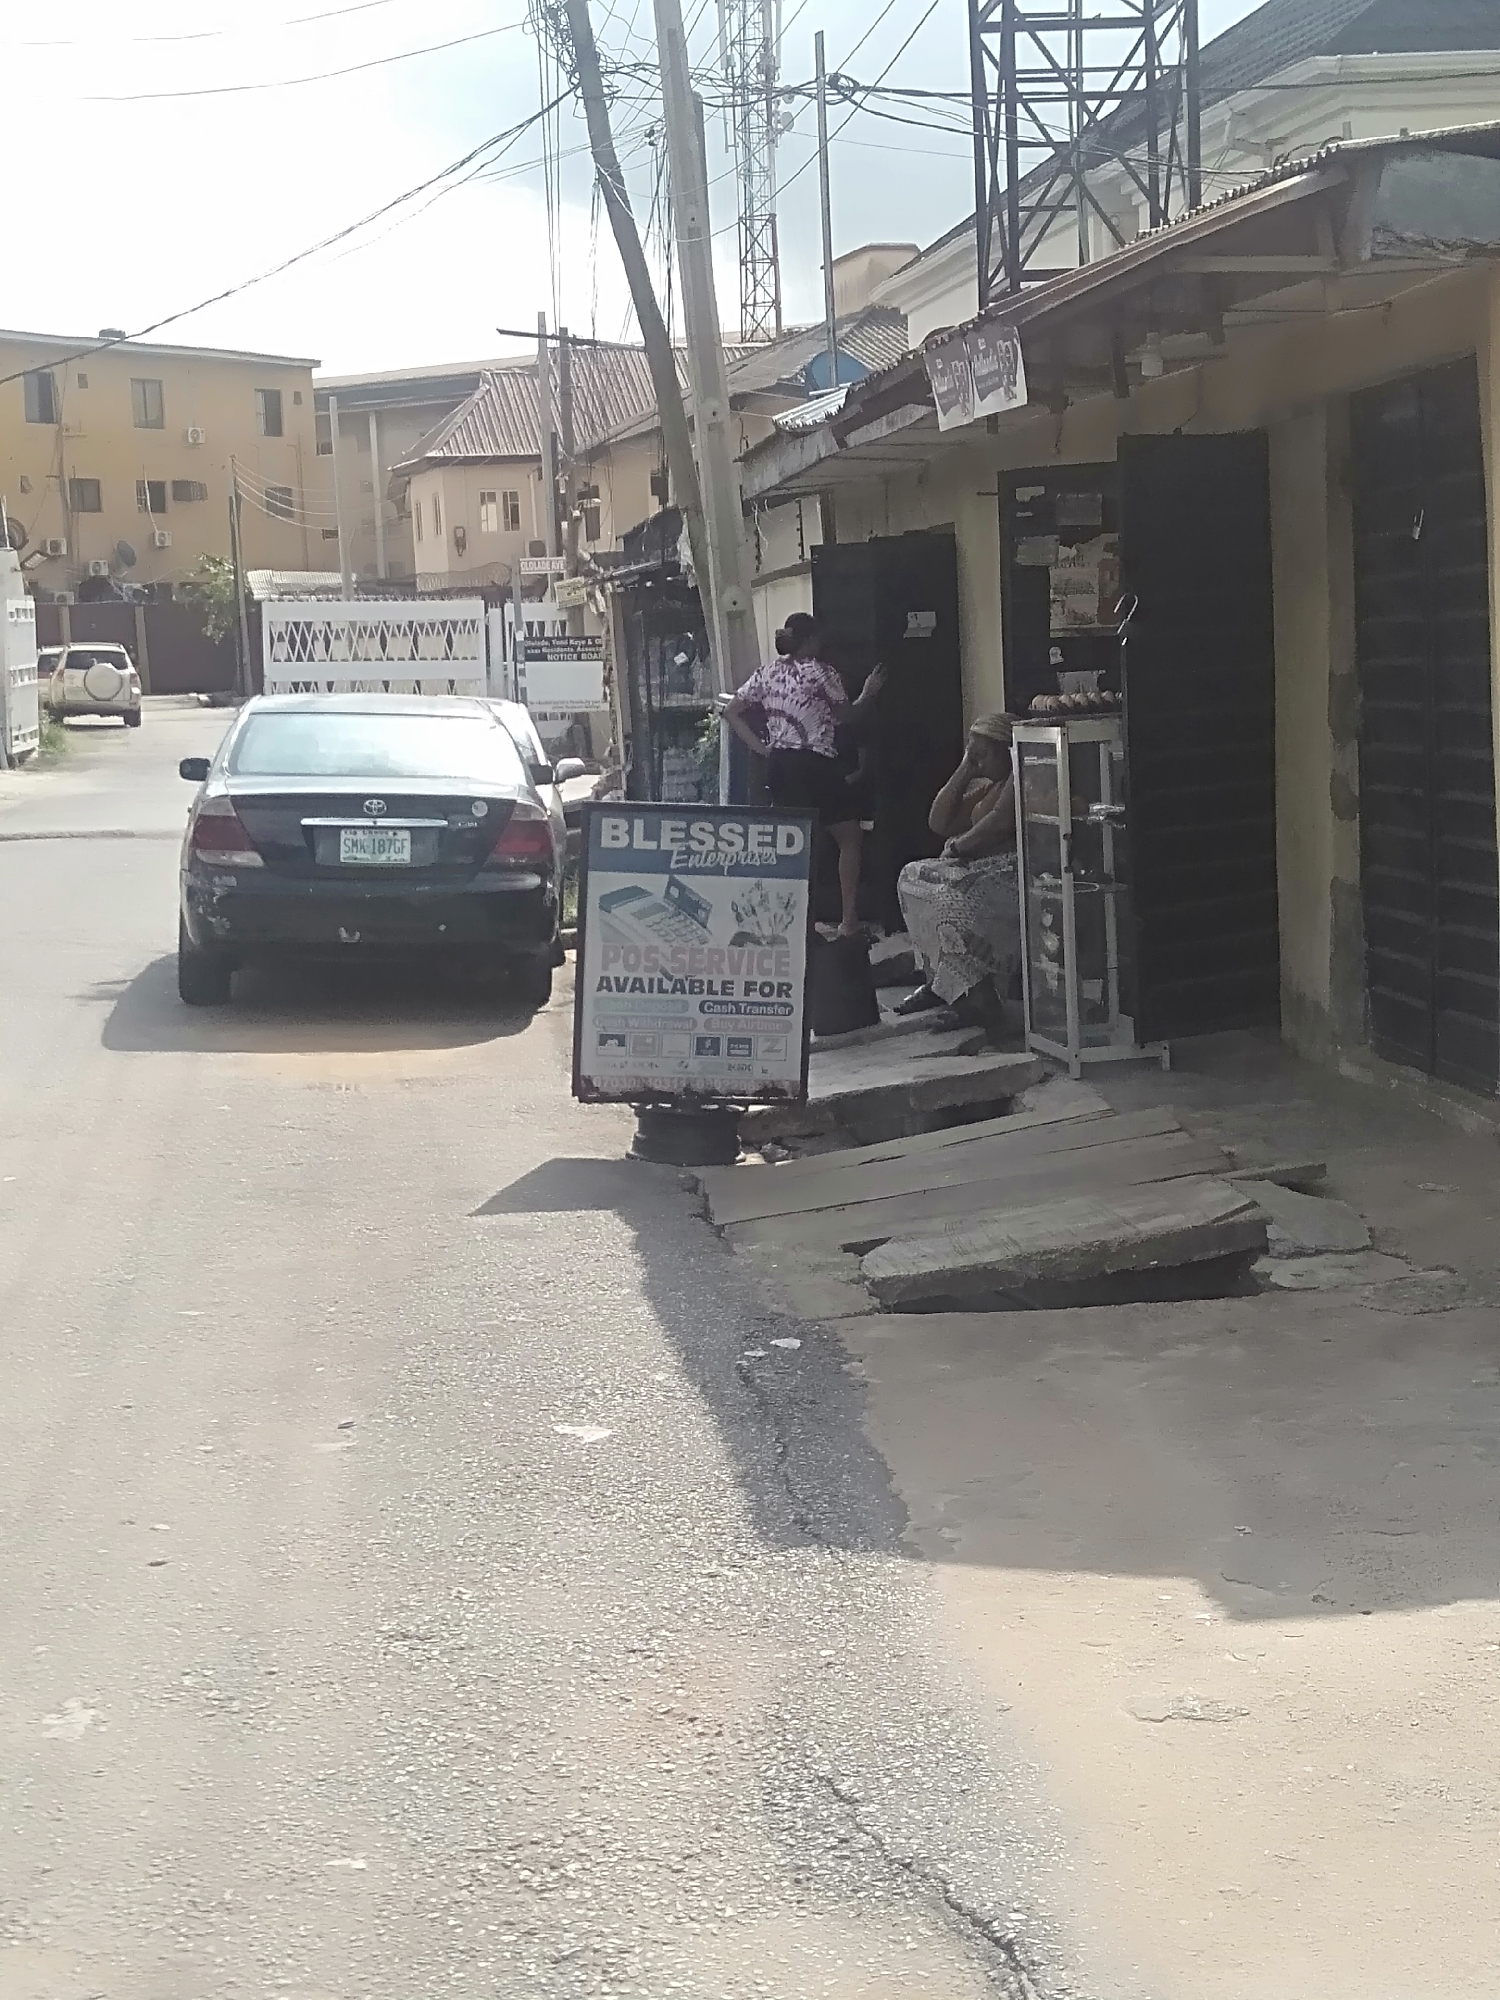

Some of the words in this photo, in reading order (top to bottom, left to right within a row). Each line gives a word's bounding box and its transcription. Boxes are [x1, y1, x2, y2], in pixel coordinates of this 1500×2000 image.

[600, 817, 805, 855] BLESSED
[670, 845, 778, 876] Enterprises
[601, 945, 661, 974] POS
[669, 947, 790, 977] SERVICE
[596, 975, 735, 997] AVAILABLE
[743, 980, 793, 998] FOR
[704, 1001, 736, 1014] Cash
[739, 1002, 792, 1016] Transfer
[628, 1017, 693, 1030] Withdrawal
[711, 1018, 735, 1030] Buy
[737, 1019, 783, 1031] Airtime
